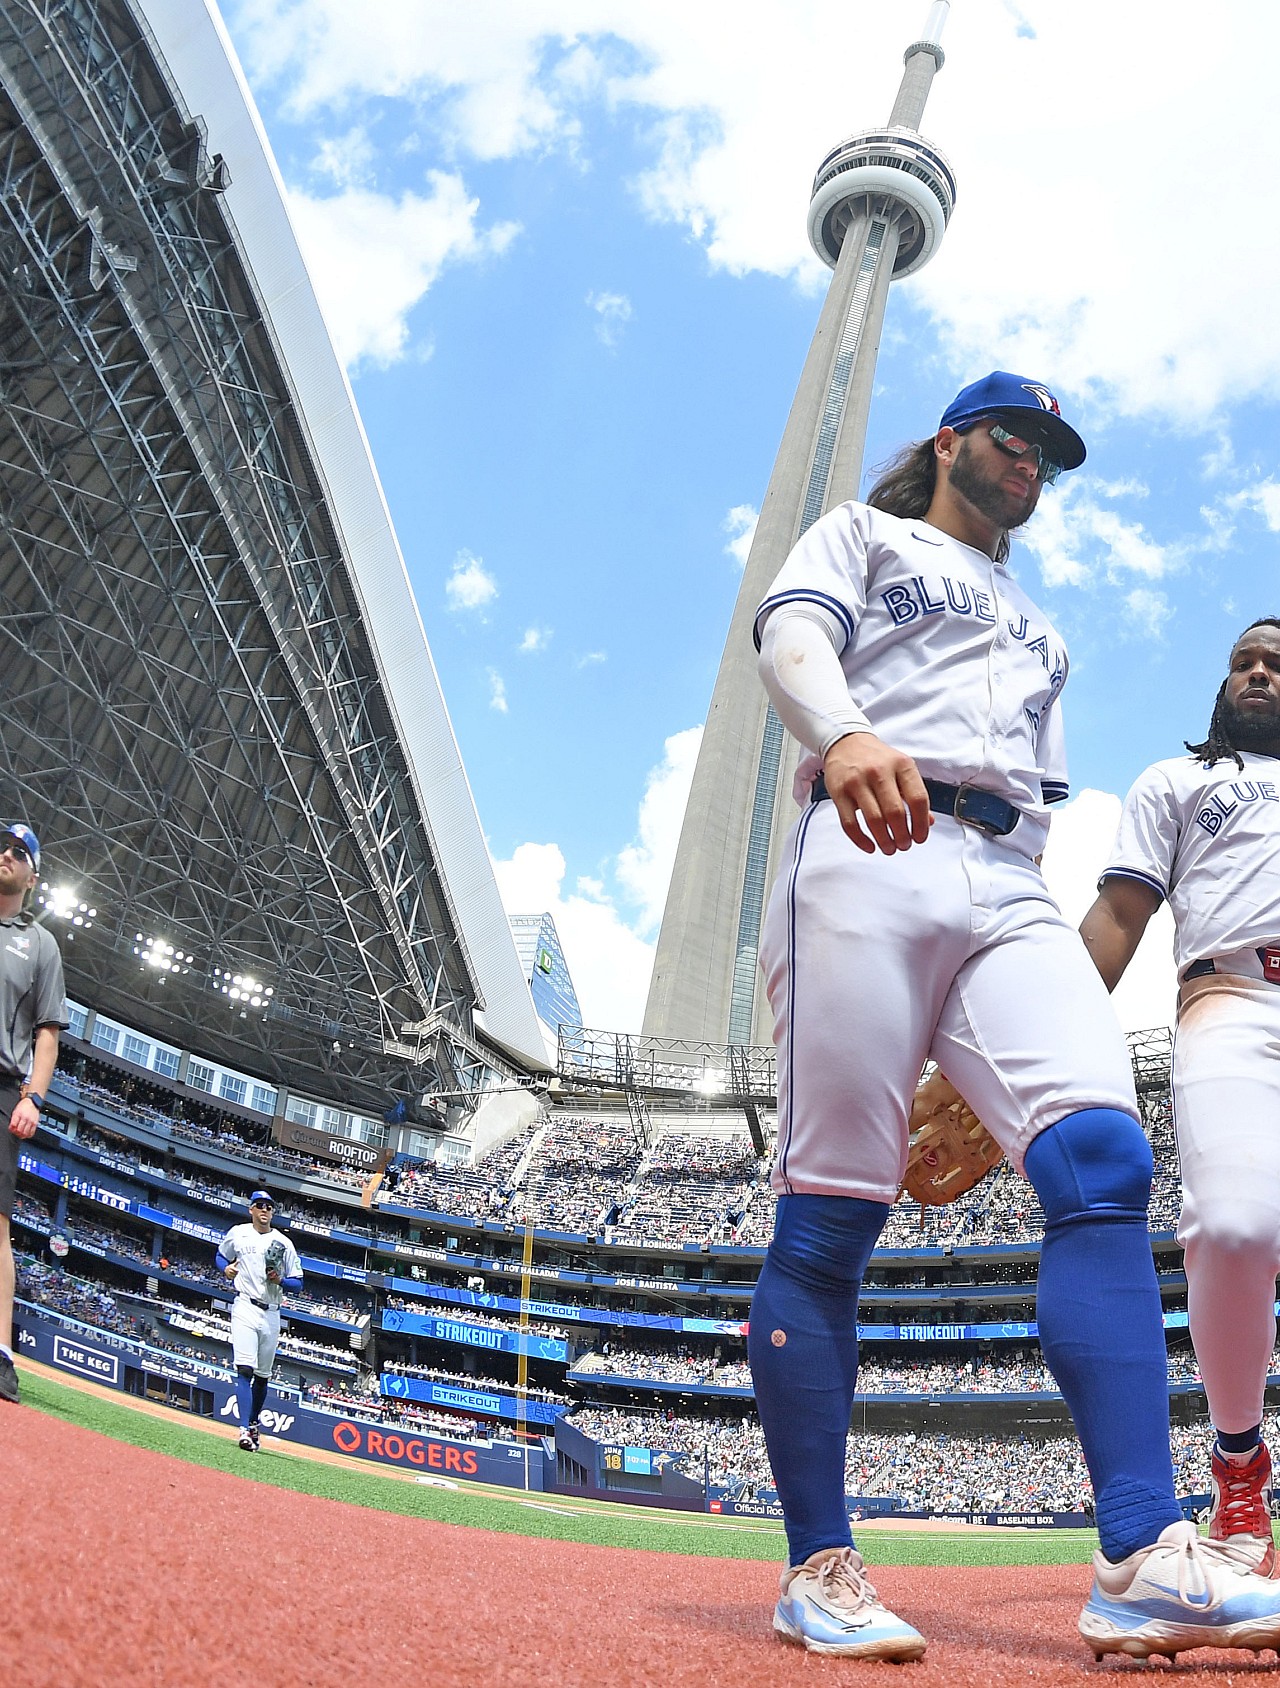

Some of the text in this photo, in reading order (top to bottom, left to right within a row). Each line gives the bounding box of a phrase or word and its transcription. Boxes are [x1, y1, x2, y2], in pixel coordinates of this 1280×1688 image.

[880, 576, 996, 627] BLUE
[1196, 781, 1279, 838] BLUE
[329, 1140, 378, 1164] ROOFTOP
[100, 1156, 135, 1176] DAVE STIEB
[342, 1156, 362, 1167] PATIO
[187, 1189, 231, 1209] CITO GASTON
[11, 1213, 51, 1235] CANADA DRY
[290, 1220, 332, 1237] PAT GILLICK
[72, 1239, 106, 1257] BLEACHERS
[395, 1245, 447, 1261] PAUL BEESTON
[615, 1238, 684, 1251] JACKIE ROBINSON
[504, 1265, 560, 1279] ROY HALLADAY
[615, 1275, 679, 1291] JOSÉ BAUTISTA
[521, 1302, 580, 1319] STRIKEOUT
[436, 1321, 504, 1349] STRIKEOUT
[900, 1325, 966, 1340] STRIKEOUT
[61, 1347, 111, 1372] THE KEG
[433, 1389, 500, 1410] STRIKEOUT
[367, 1430, 479, 1474] ROGERS
[507, 1449, 522, 1458] 328
[604, 1447, 623, 1456] JUNE
[604, 1454, 622, 1470] 18
[734, 1502, 765, 1515] Official
[973, 1516, 988, 1525] BET
[997, 1516, 1036, 1525] BASELINE
[1037, 1516, 1054, 1525] BOX
